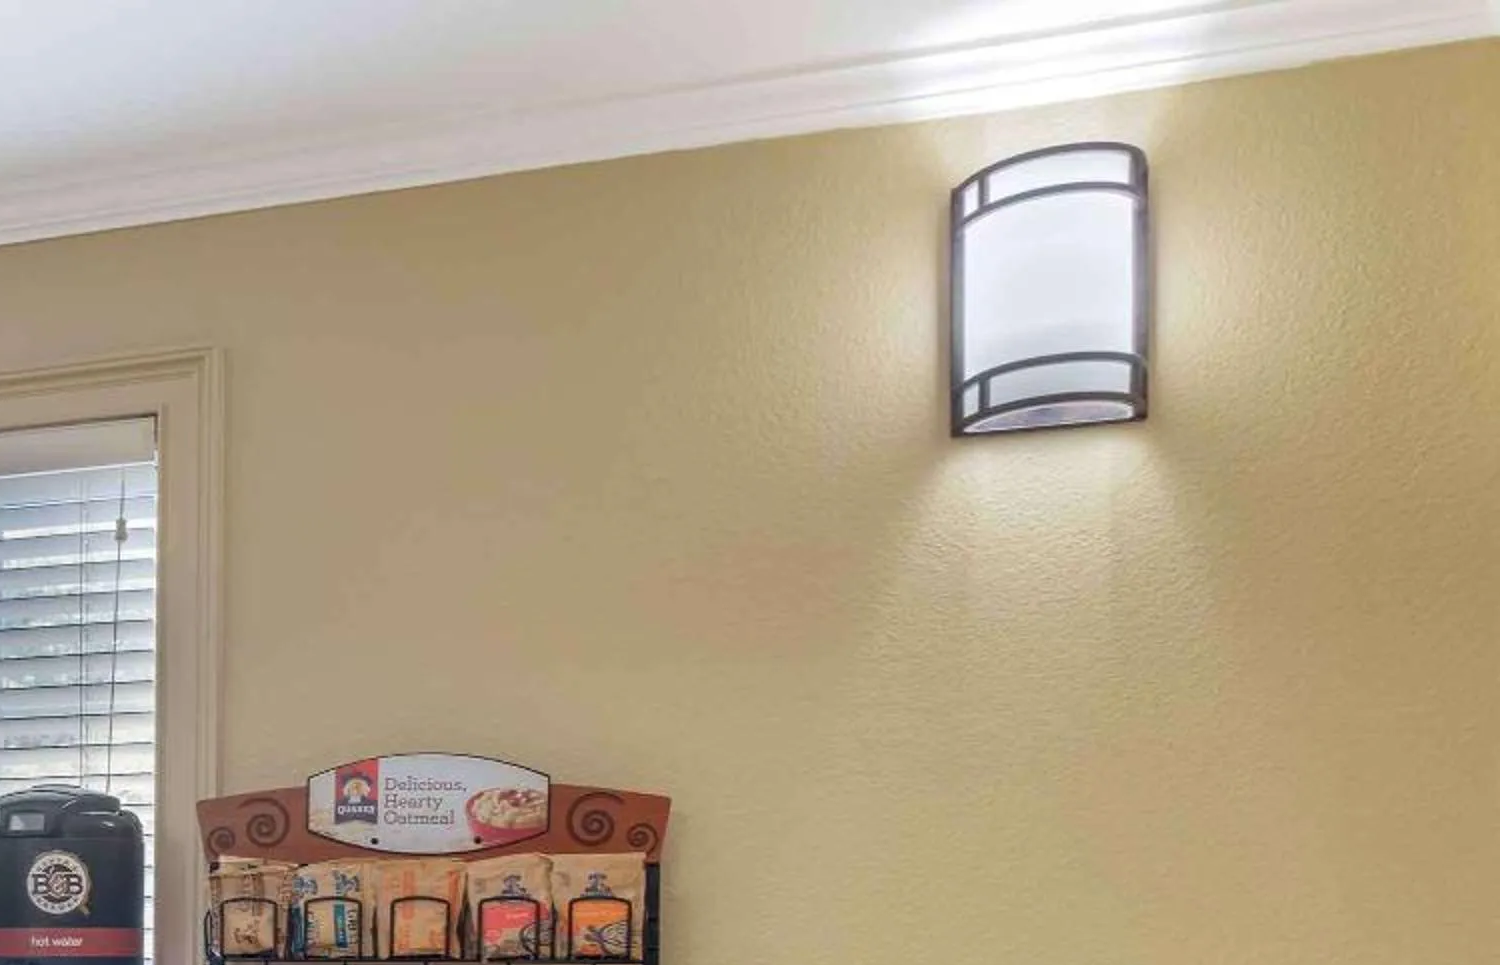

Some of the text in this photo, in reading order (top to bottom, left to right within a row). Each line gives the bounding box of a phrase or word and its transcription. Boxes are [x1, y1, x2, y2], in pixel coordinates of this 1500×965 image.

[384, 776, 467, 792] Delicious,
[384, 794, 443, 811] Hearty
[383, 810, 455, 825] Oatmeal
[31, 935, 84, 948] hot water
